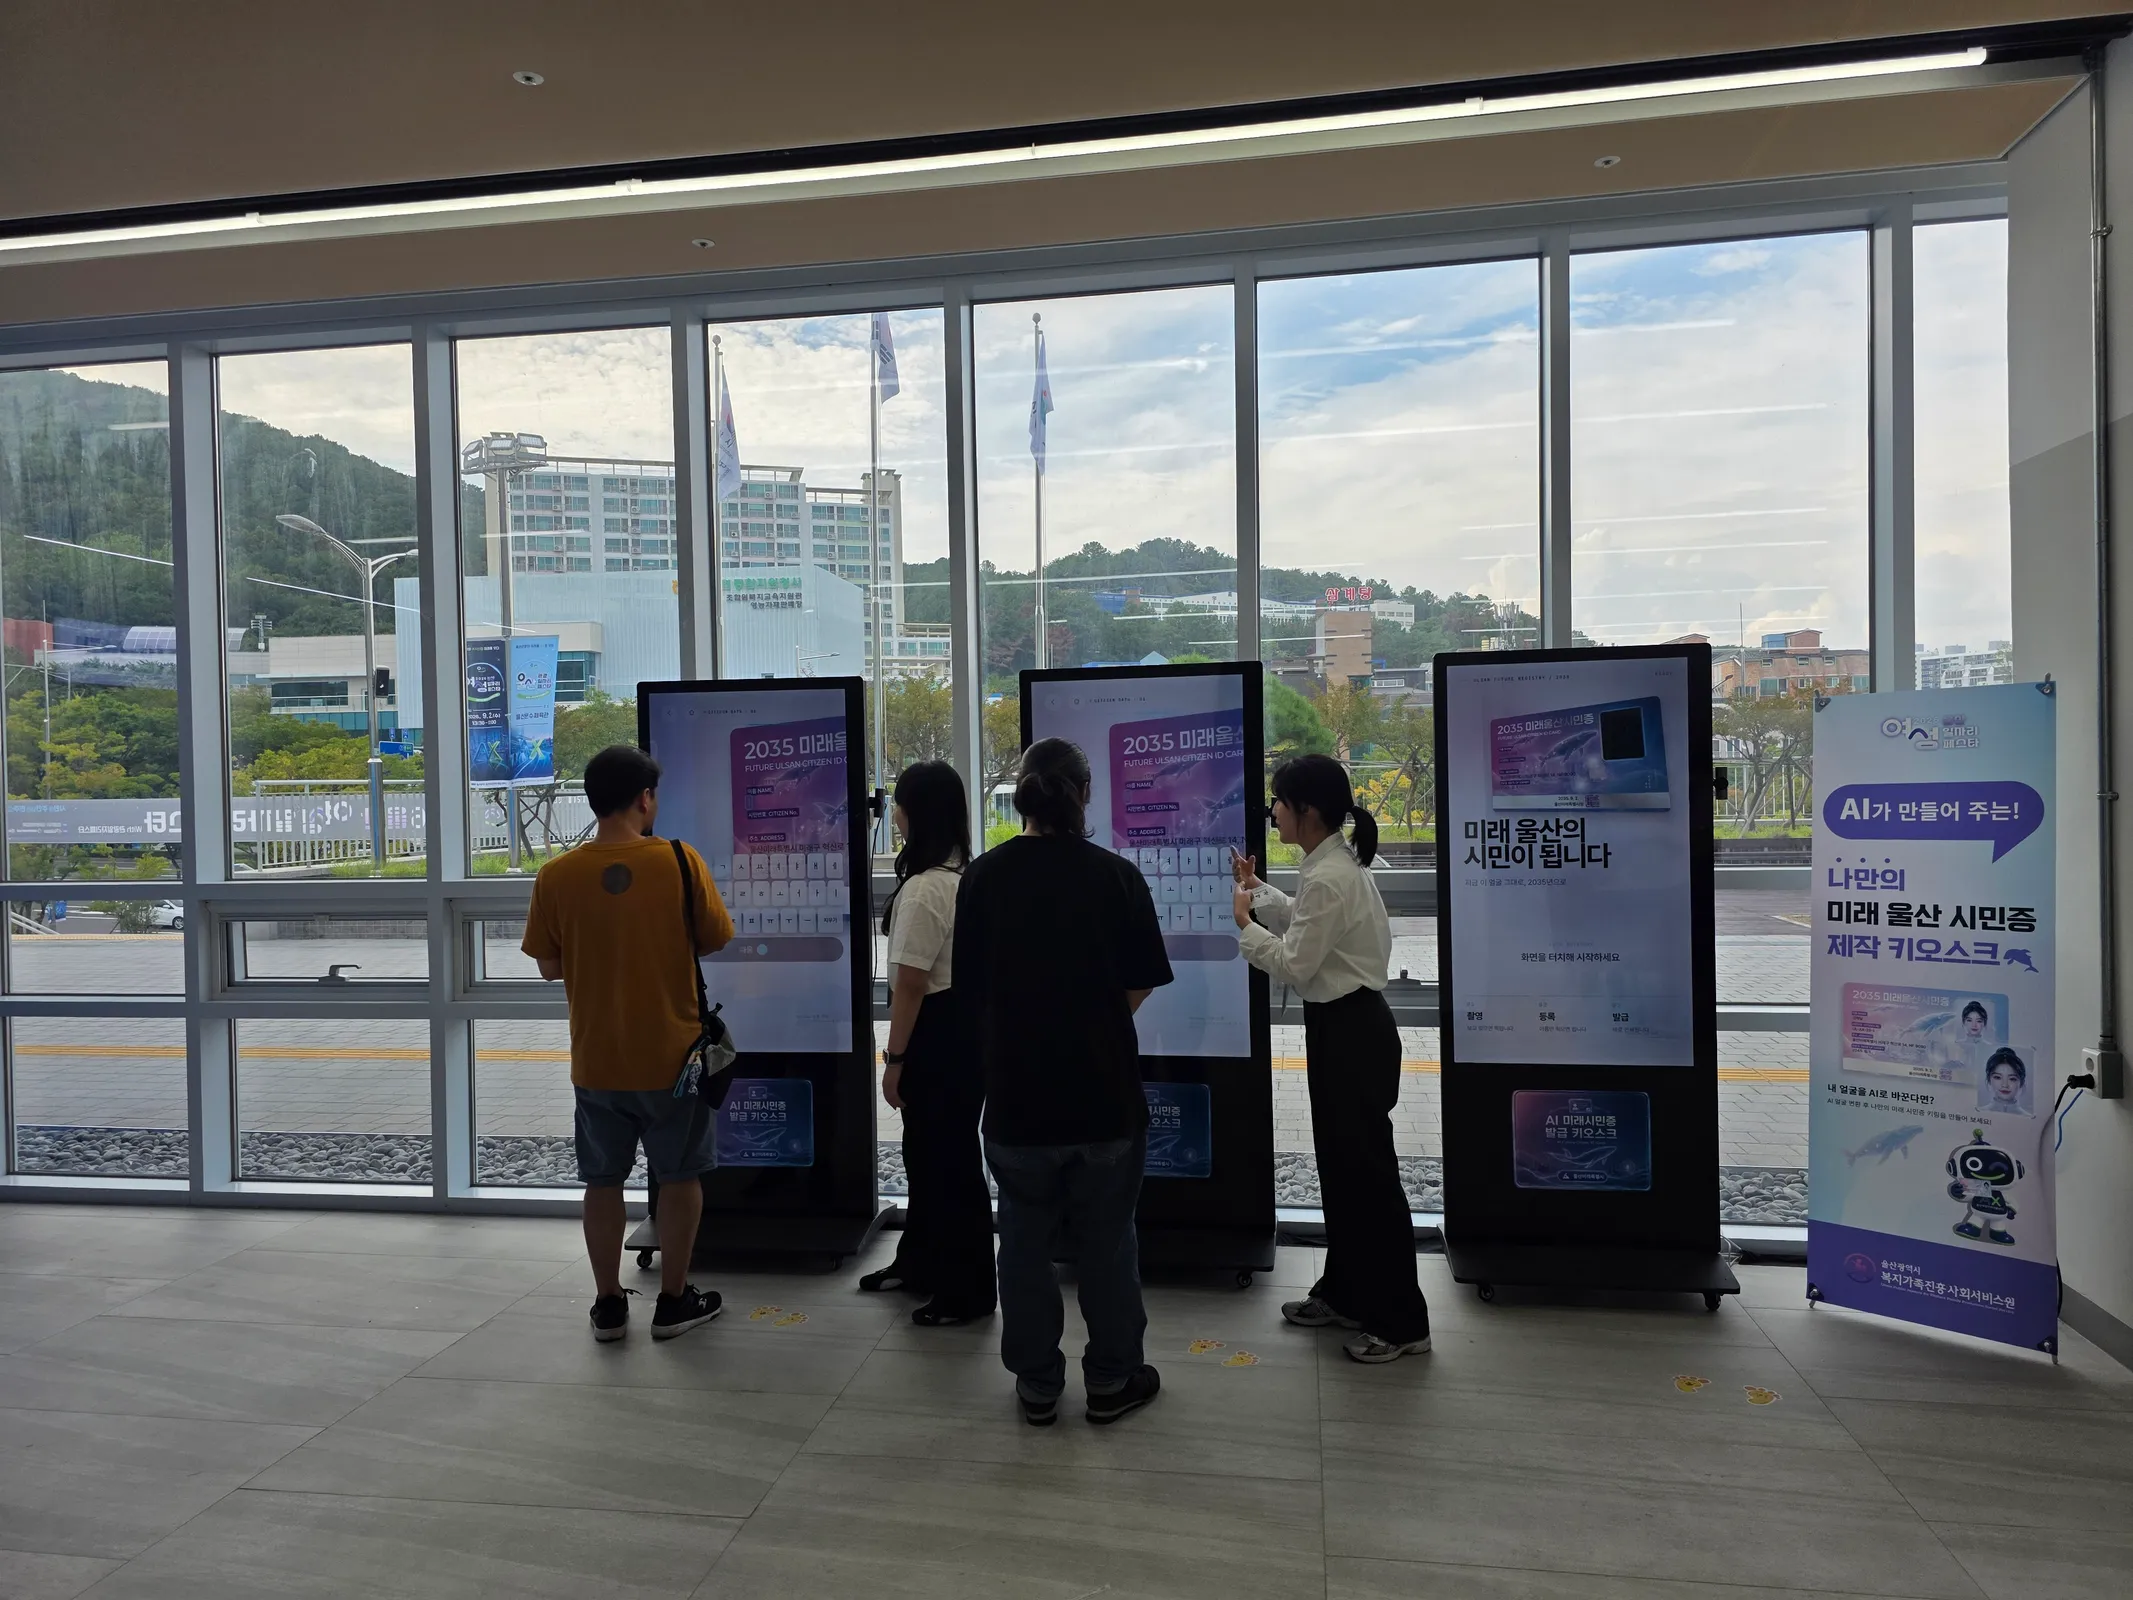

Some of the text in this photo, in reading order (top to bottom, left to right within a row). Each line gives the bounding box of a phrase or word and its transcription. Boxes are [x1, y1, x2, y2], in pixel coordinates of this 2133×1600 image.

[1325, 586, 1373, 602] 삼계탕
[750, 601, 802, 610] 영농자재판매장
[1497, 713, 1594, 735] 2035 미래울산시민증
[1943, 726, 1978, 737] 일자리
[1881, 717, 1938, 751] 여성
[744, 738, 794, 760] 2035
[1123, 733, 1174, 755] 2035
[1943, 738, 1980, 749] 페스타
[745, 763, 774, 773] FUTURE
[775, 761, 800, 770] ULSAN
[802, 758, 832, 768] CITIZEN
[834, 757, 842, 765] ID
[1124, 758, 1154, 768] FUTURE
[1154, 756, 1180, 765] ULSAN
[1181, 753, 1213, 762] CITIZEN
[1214, 751, 1224, 760] ID
[1840, 798, 2020, 822] AI가 만들어 주는!
[1464, 818, 1586, 844] 미래 울산의
[799, 843, 820, 852] 미래구
[822, 842, 844, 851] 혁신로
[1180, 837, 1202, 846] 미래구
[1228, 836, 1240, 845] 14,
[1464, 842, 1612, 869] 시민이 됩니다
[1488, 878, 1502, 886] 얼굴
[1504, 878, 1526, 887] 그대로,
[1528, 878, 1566, 886] 2035년으로
[1828, 868, 1905, 892] 나만의
[1827, 900, 2038, 932] 미래 울산 시민증
[1521, 952, 1620, 962] 화면을 터치해 시작하세요
[1827, 934, 2001, 966] 제작 키오스크
[1852, 990, 1880, 1000] 2035
[1883, 992, 1950, 1006] 미래울산시민증
[1467, 1012, 1483, 1020] 촬영
[1539, 1012, 1556, 1021] 등록
[1612, 1013, 1629, 1022] 발급
[1828, 1084, 1934, 1105] 내 얼굴을 AI로 바꾼다면?
[730, 1101, 786, 1110] AI 미래시민증
[1835, 1098, 1846, 1106] 얼굴
[1848, 1100, 1861, 1108] 변환
[1870, 1104, 1890, 1112] 나만의
[1892, 1106, 1904, 1114] 미래
[1906, 1108, 1925, 1116] 시민증
[1927, 1110, 1946, 1120] 키링을
[1948, 1114, 1968, 1122] 만들어
[1970, 1116, 1992, 1126] 보세요!
[730, 1112, 787, 1122] 발급 키오스크
[1545, 1115, 1617, 1126] AI 미래시민증
[1545, 1128, 1618, 1140] 발급 키오스크
[1880, 1260, 1921, 1275] 울산광역시
